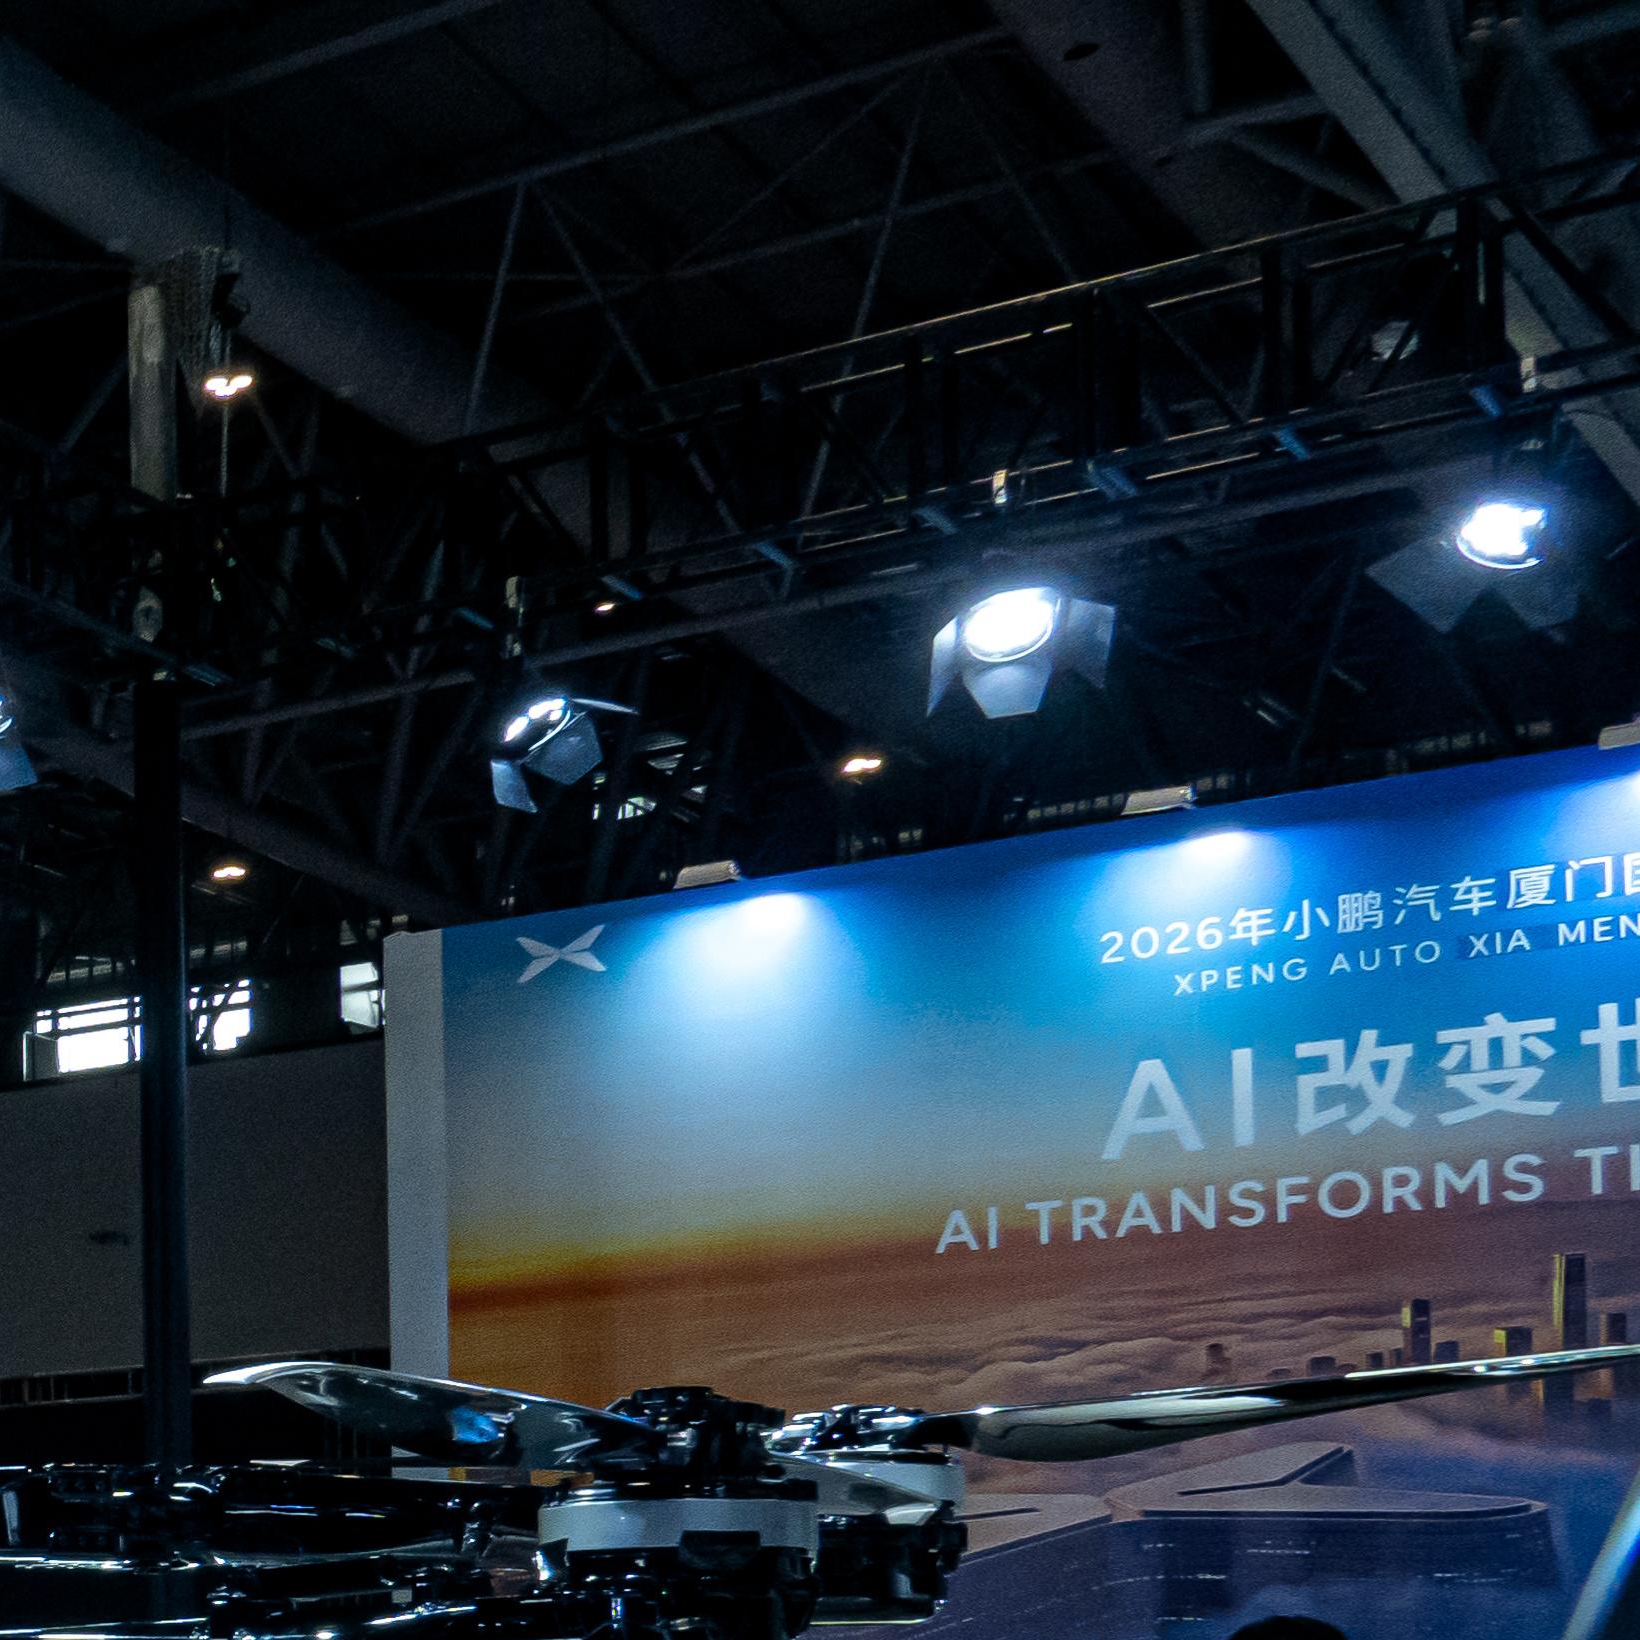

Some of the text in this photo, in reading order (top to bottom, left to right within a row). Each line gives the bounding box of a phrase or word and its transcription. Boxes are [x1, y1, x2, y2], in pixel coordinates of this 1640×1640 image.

[1174, 957, 1308, 996] XPENG
[1329, 940, 1441, 976] AUTO
[1469, 928, 1531, 958] XIA
[935, 1205, 998, 1256] AI
[1026, 1153, 1545, 1246] TRANSFORMS
